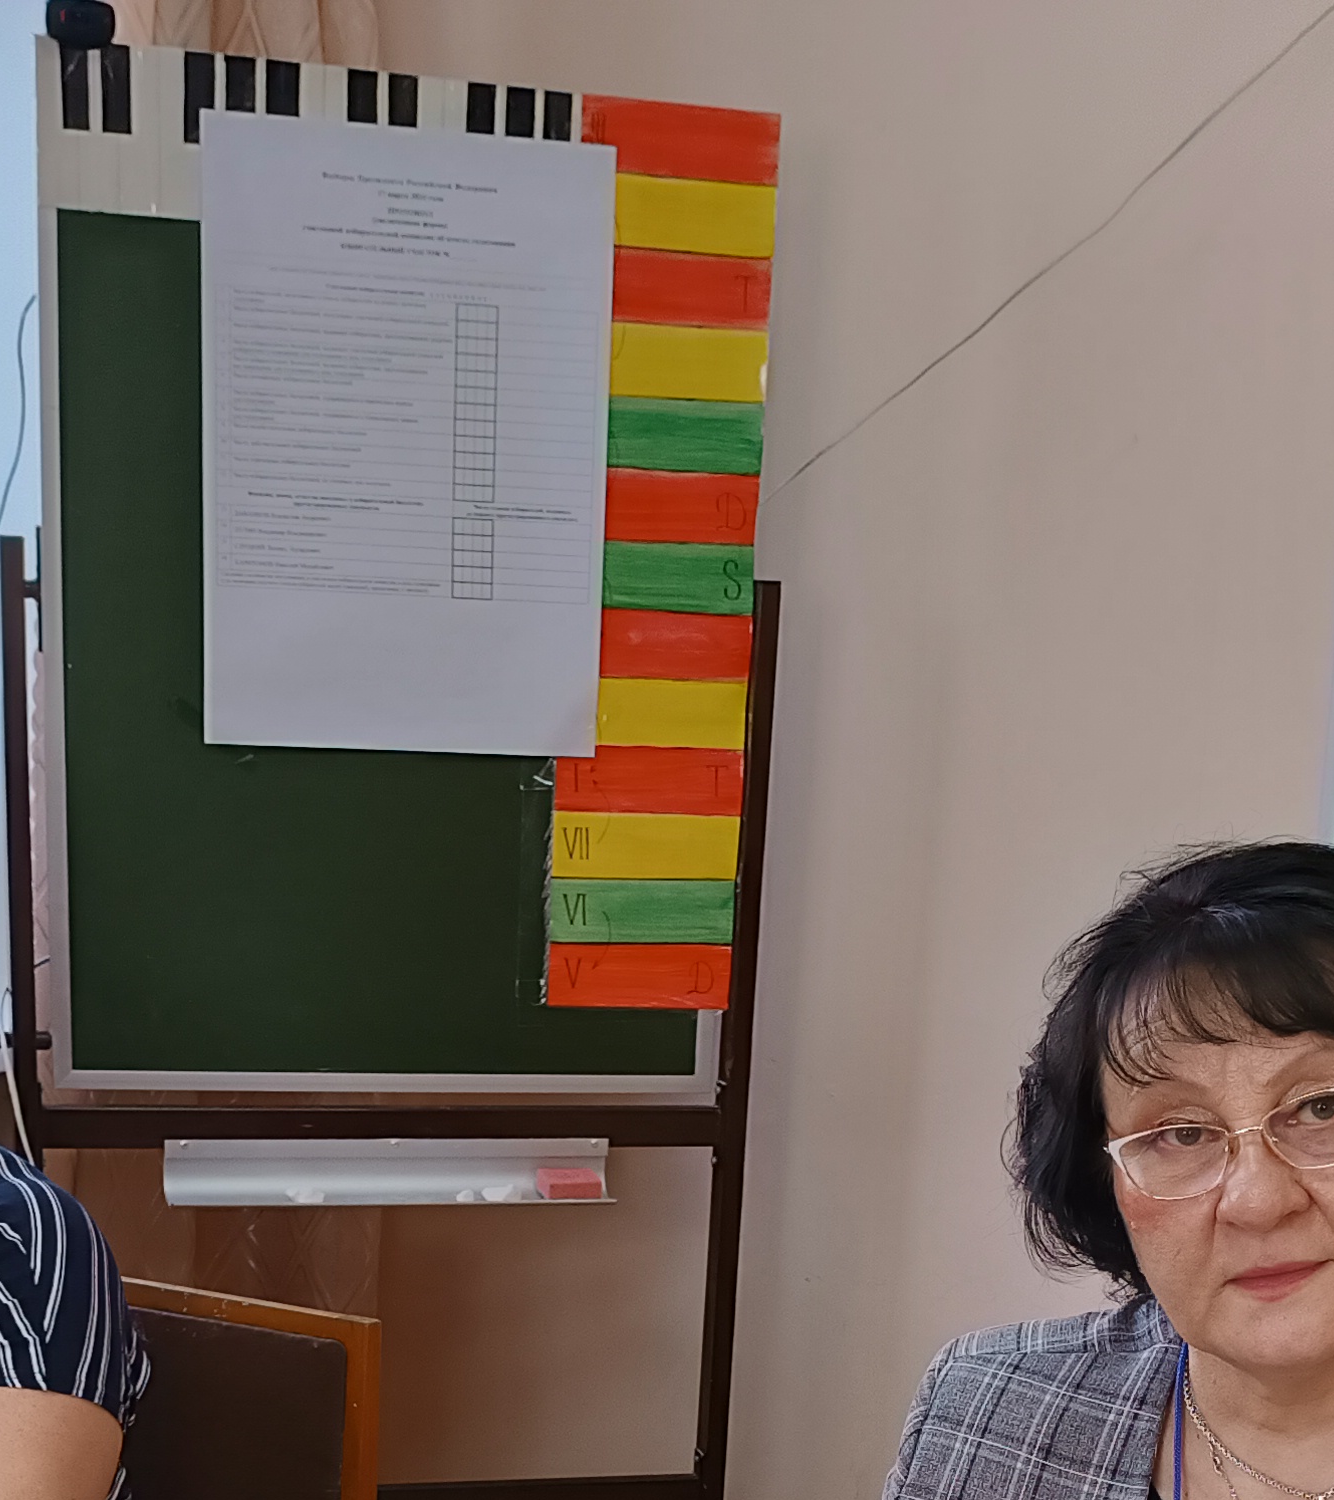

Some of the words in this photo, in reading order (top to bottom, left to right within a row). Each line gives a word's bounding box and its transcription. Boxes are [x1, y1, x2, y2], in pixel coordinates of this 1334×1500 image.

[734, 275, 757, 313] T
[716, 492, 747, 531] D
[722, 559, 741, 601] S
[706, 764, 728, 798] T
[562, 827, 590, 860] VII
[562, 893, 587, 926] VI
[564, 957, 582, 989] V
[687, 961, 714, 995] D
